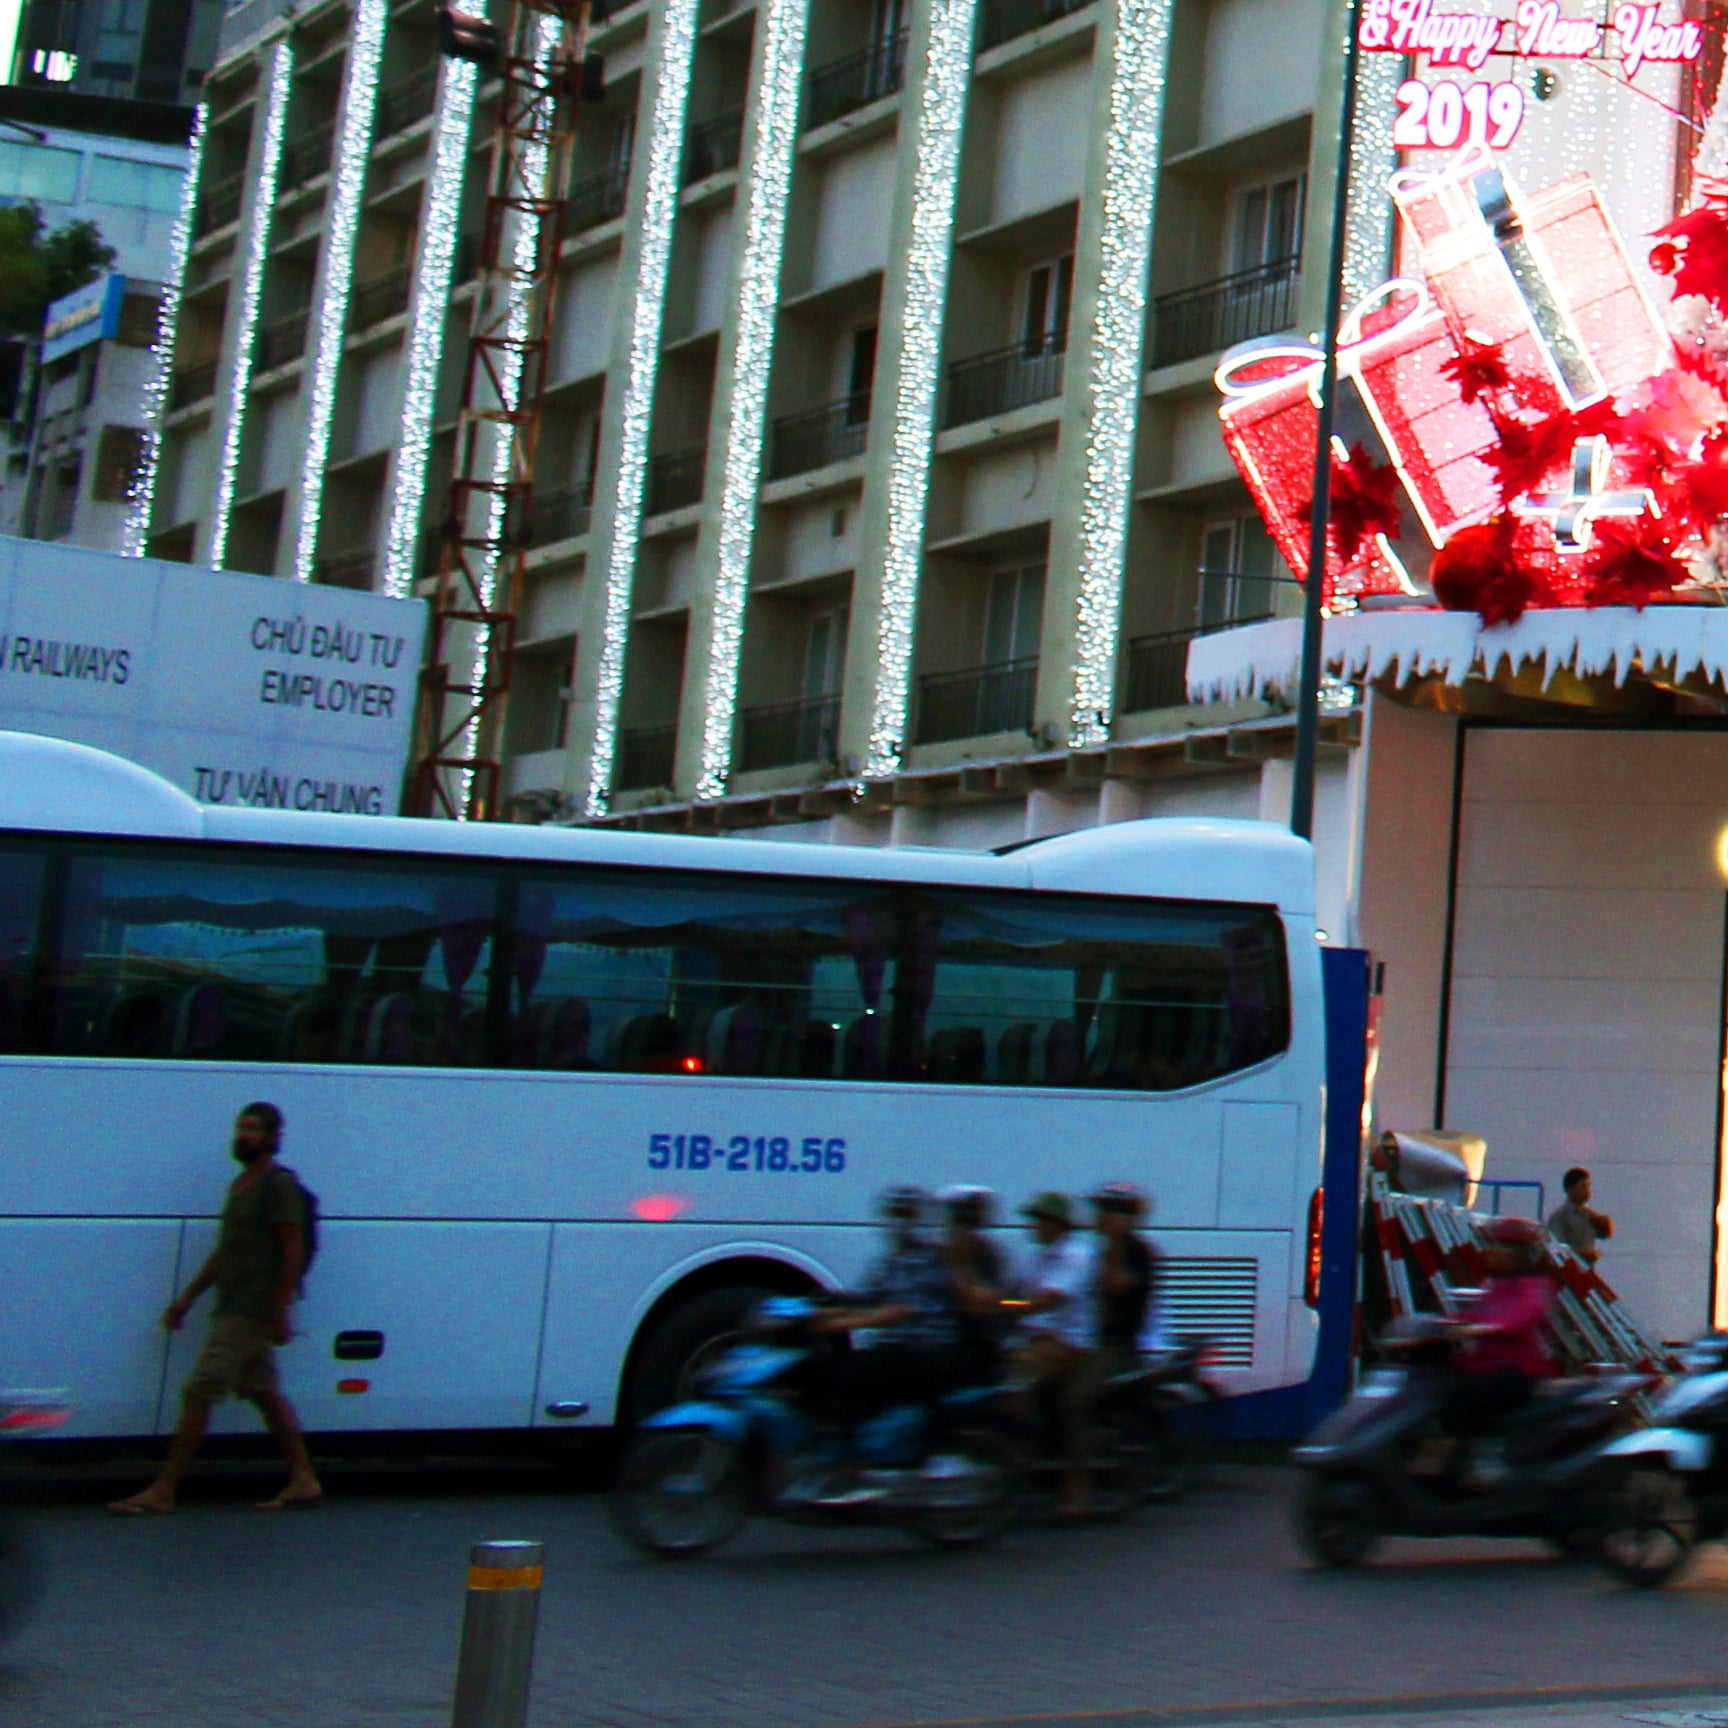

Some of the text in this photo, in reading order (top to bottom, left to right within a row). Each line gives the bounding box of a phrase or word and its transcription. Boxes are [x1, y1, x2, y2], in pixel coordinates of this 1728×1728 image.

[1515, 0, 1602, 57] New
[1613, 3, 1703, 80] Year
[1394, 80, 1525, 149] 2019
[10, 636, 132, 684] RAILWAYS
[260, 670, 396, 719] EMPLOYER
[295, 778, 383, 816] CHUNG
[648, 1133, 847, 1173] 51B-218.56
